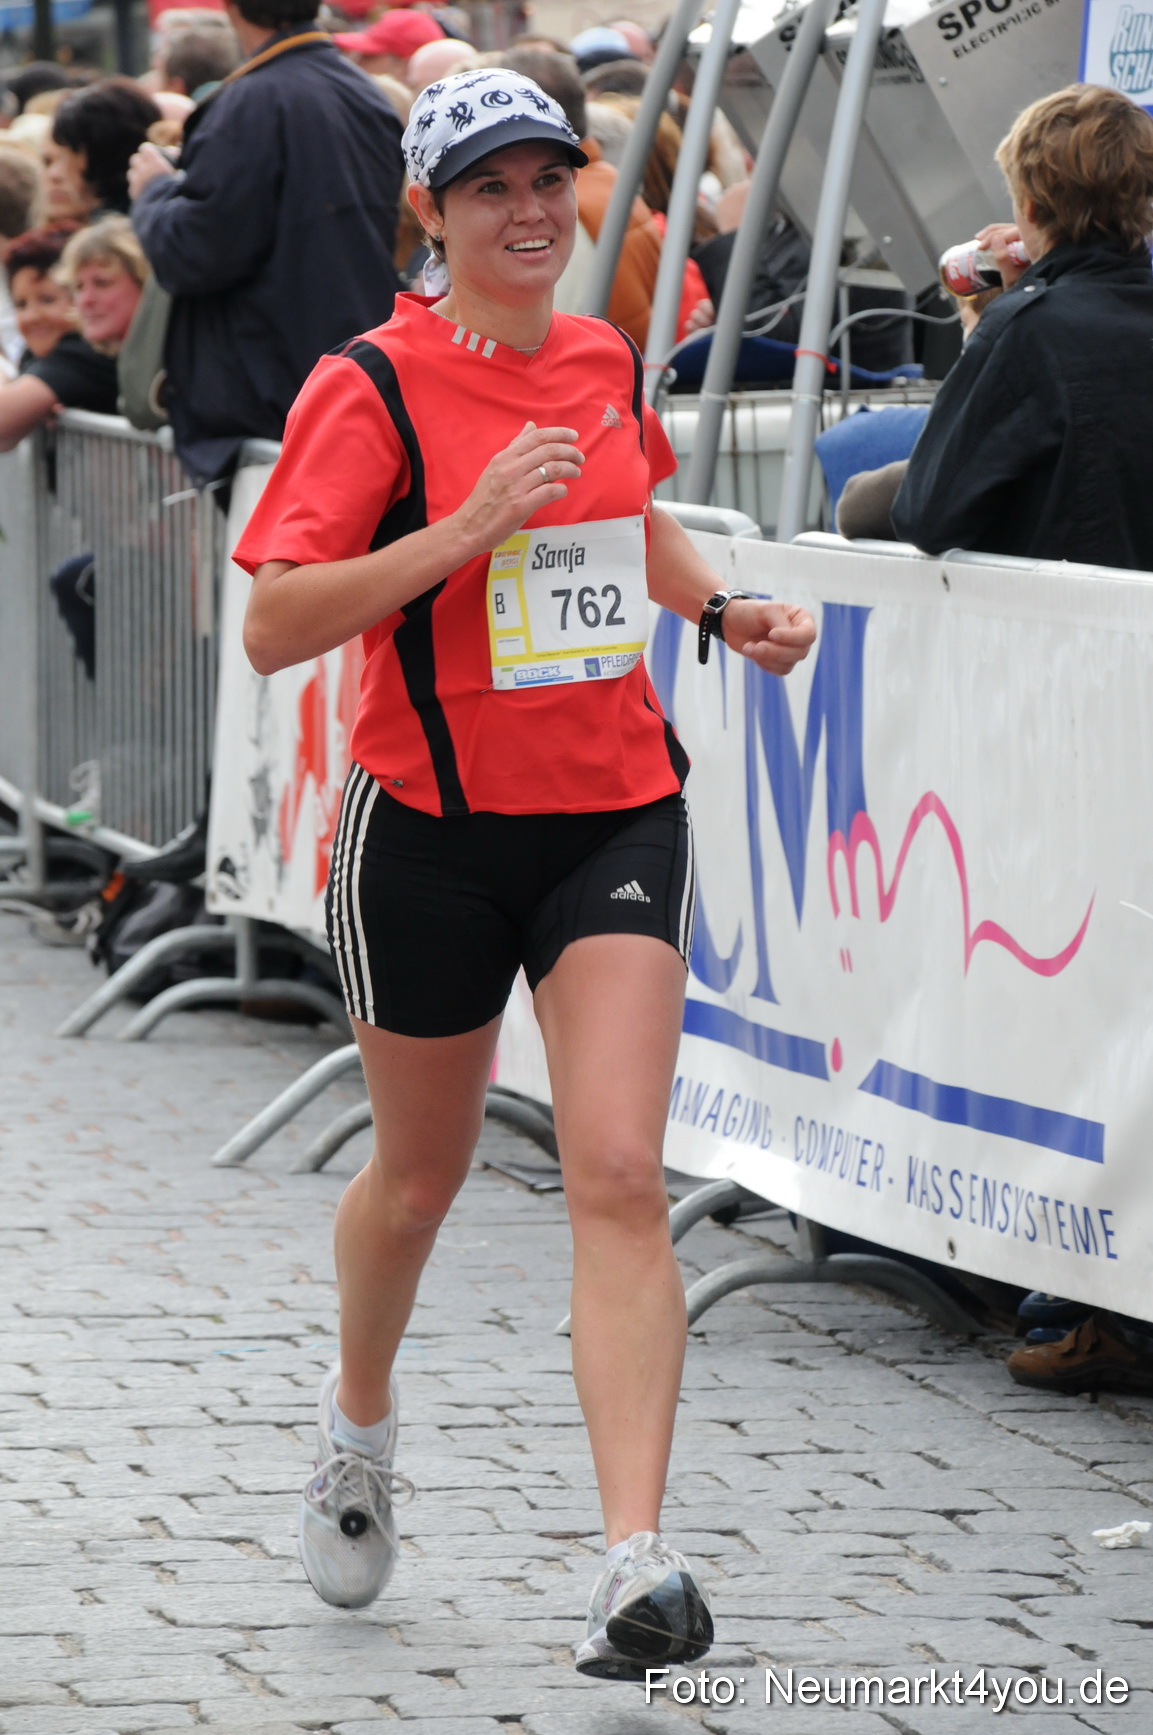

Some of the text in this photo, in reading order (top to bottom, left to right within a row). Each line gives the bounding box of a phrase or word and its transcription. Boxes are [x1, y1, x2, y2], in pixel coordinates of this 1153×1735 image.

[531, 542, 586, 573] Sonja
[495, 592, 506, 615] B
[551, 584, 626, 631] 762
[610, 891, 651, 903] adidas
